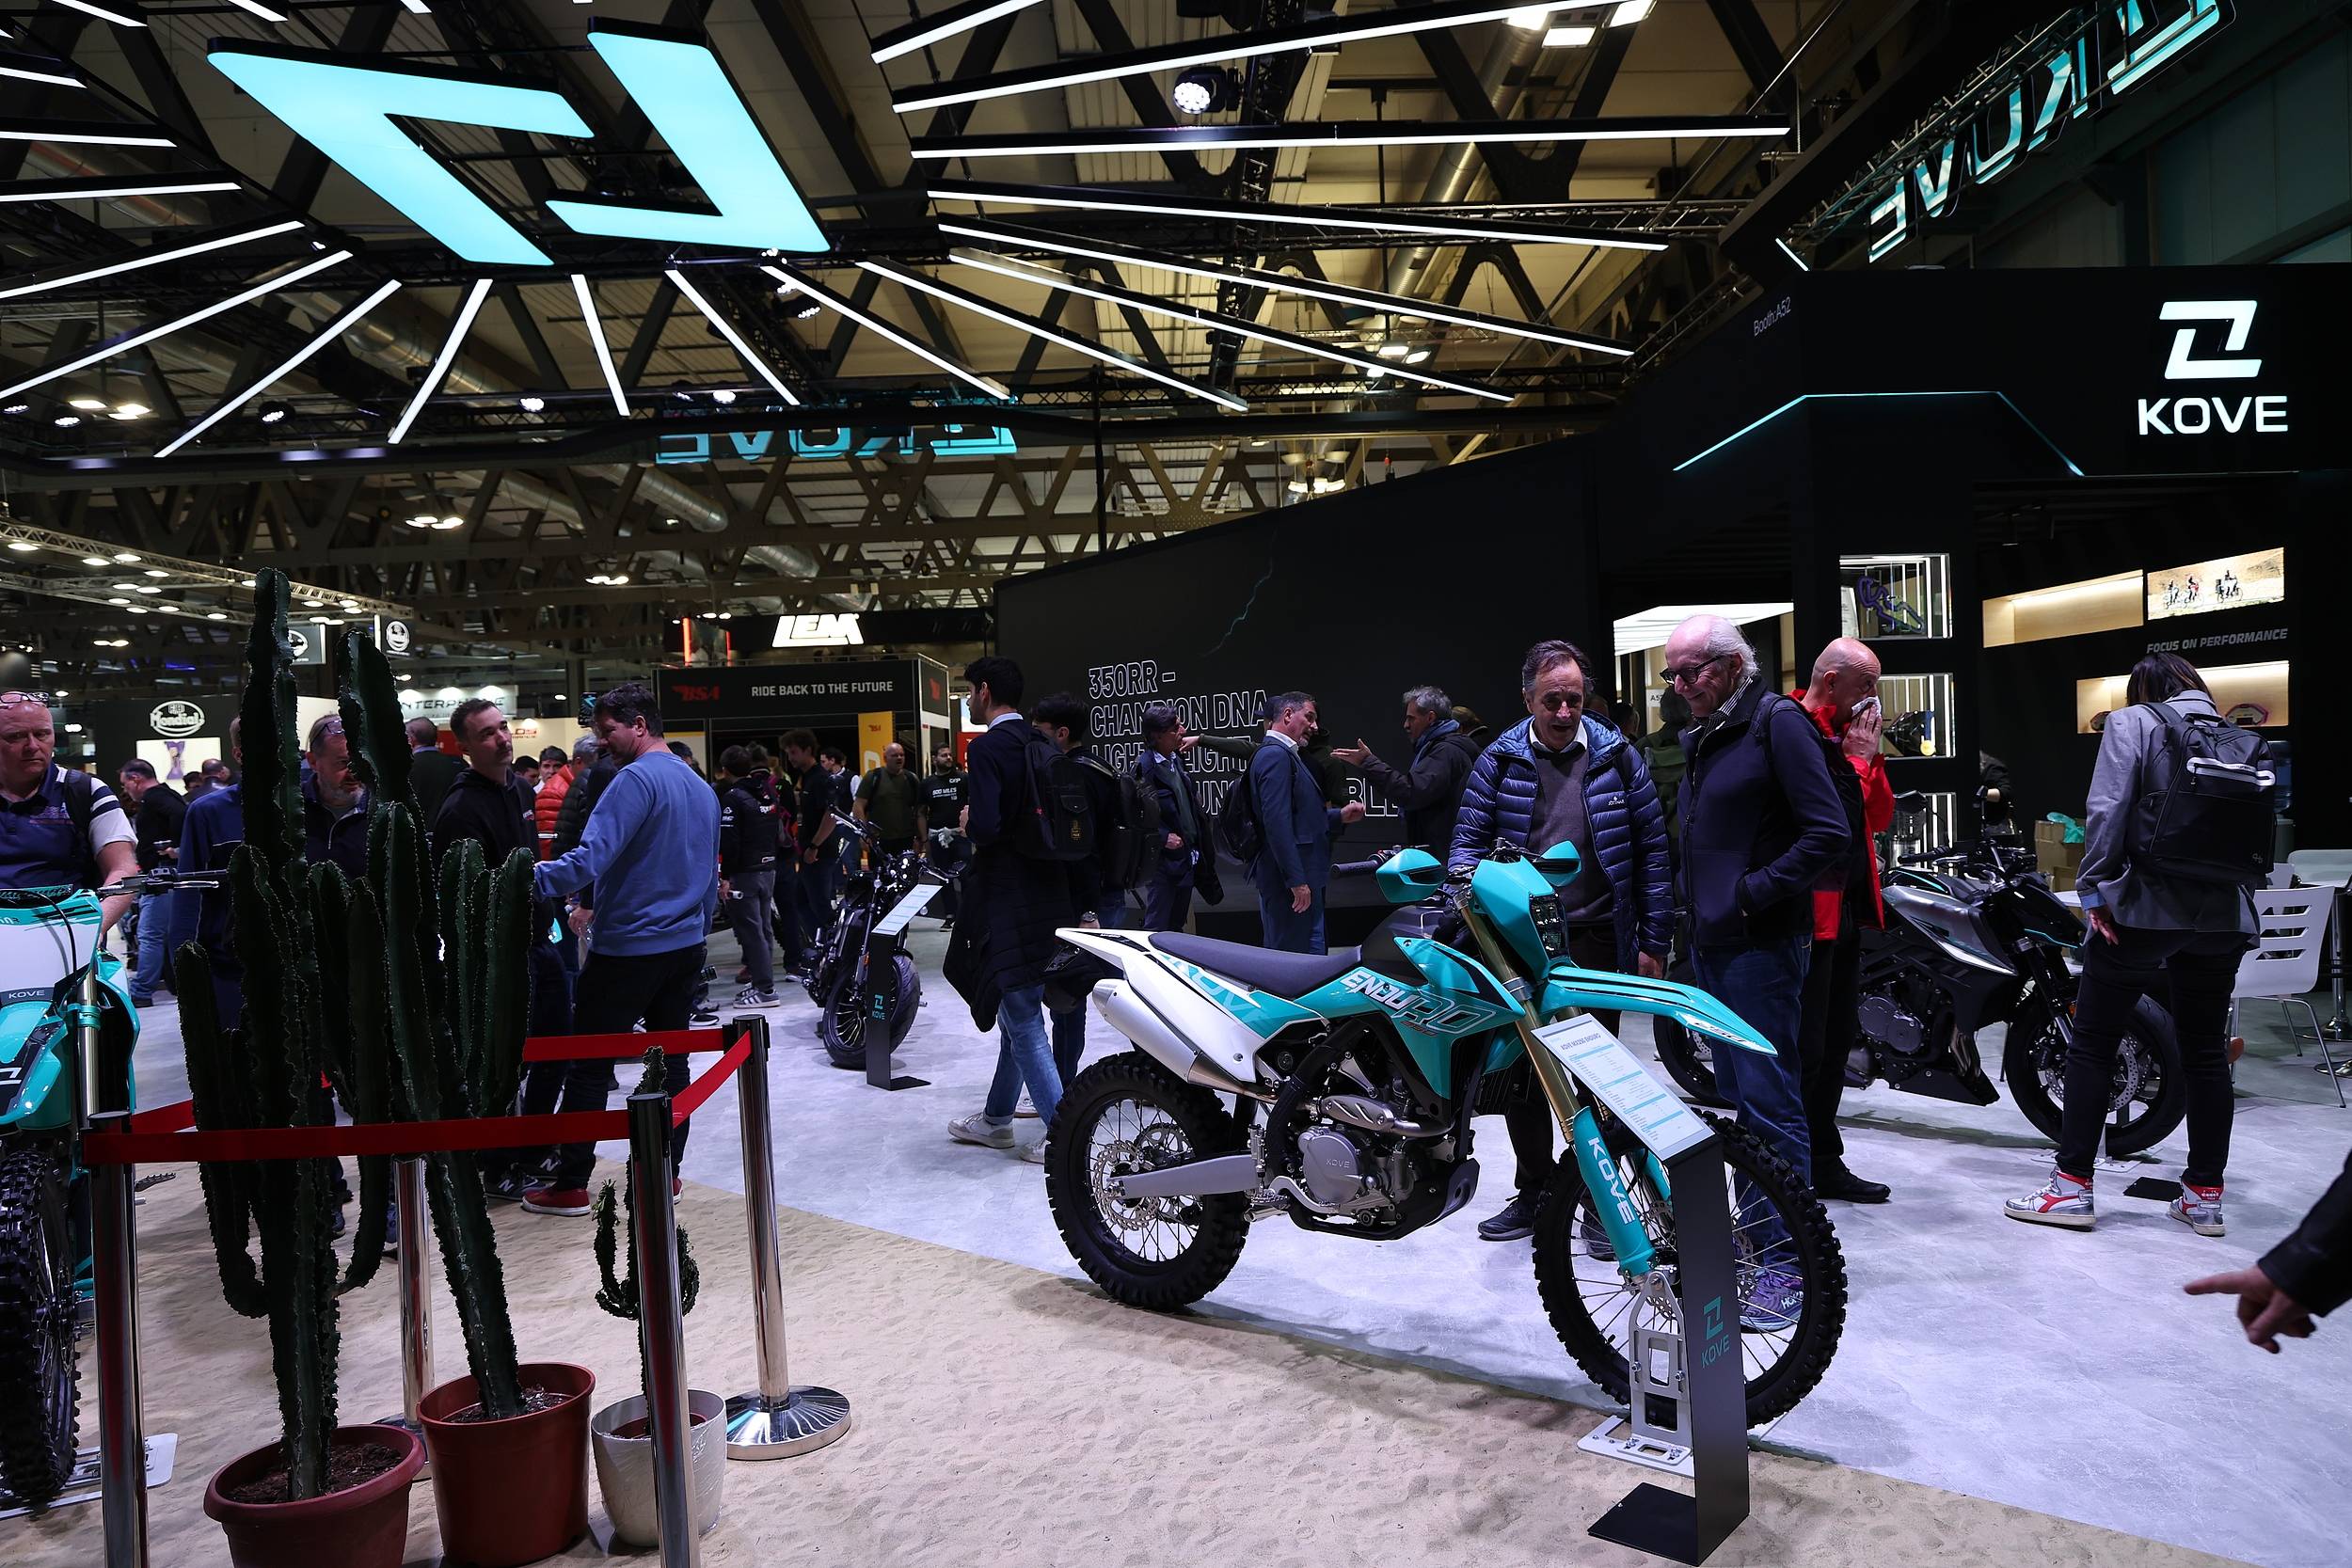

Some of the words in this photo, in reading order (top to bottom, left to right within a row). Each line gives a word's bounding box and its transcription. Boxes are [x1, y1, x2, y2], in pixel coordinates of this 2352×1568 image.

[2137, 395, 2289, 436] KOVE
[772, 613, 864, 647] LEM
[2147, 641, 2180, 654] FOCUS
[2182, 639, 2198, 649] ON
[2200, 628, 2289, 647] PERFORMANCE
[752, 686, 776, 697] RIDE
[779, 684, 808, 695] BACK
[811, 684, 825, 694] TO
[828, 682, 849, 693] THE
[851, 681, 894, 692] FUTURE
[1089, 660, 1158, 699] 350RR
[1214, 689, 1267, 729] DNA
[8, 990, 45, 999] KOVE
[1340, 970, 1497, 1034] ENDURO
[1326, 1158, 1351, 1168] KOVE
[1588, 1136, 1635, 1225] KOVE
[1701, 1334, 1730, 1370] KOVE
